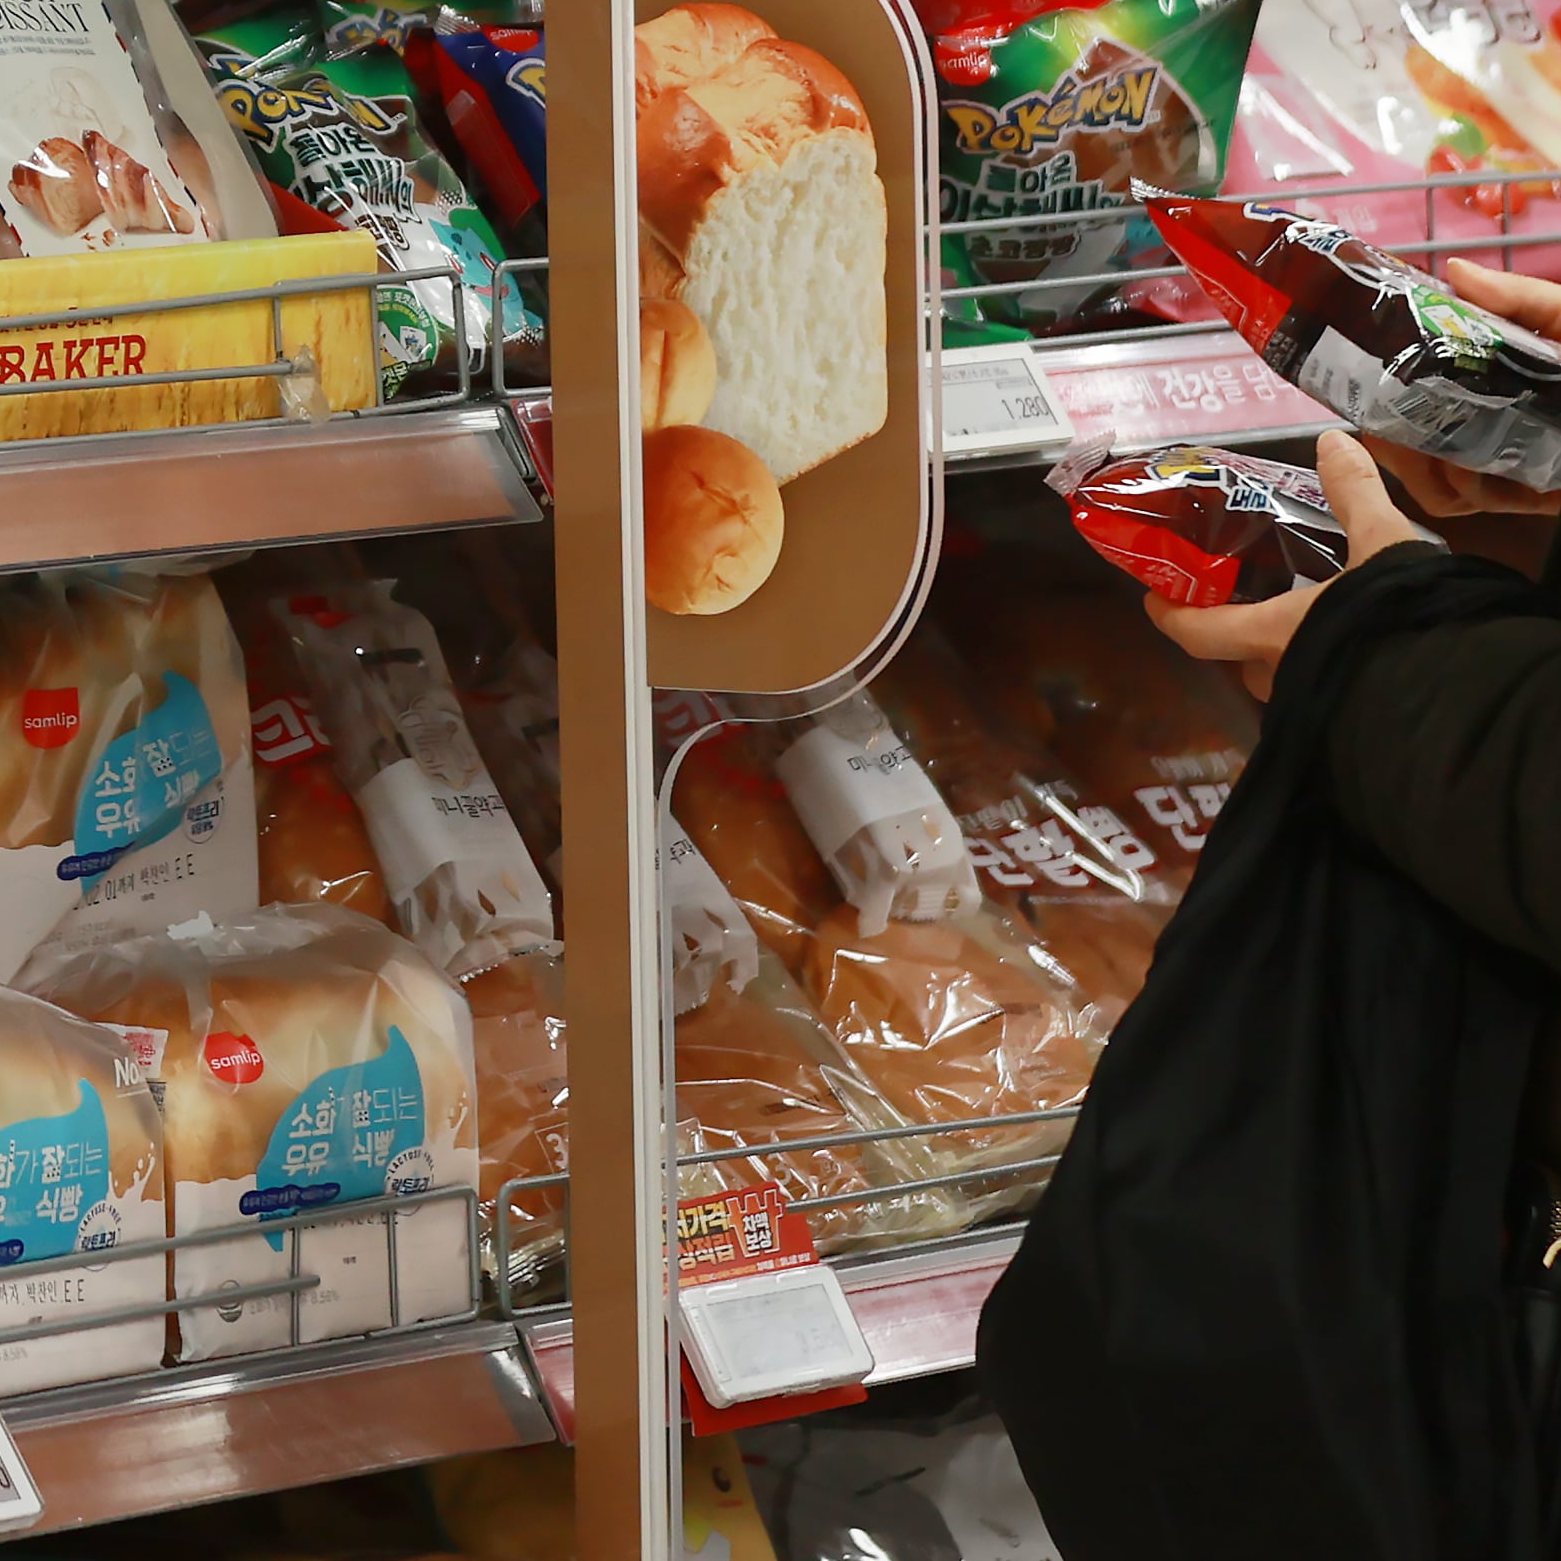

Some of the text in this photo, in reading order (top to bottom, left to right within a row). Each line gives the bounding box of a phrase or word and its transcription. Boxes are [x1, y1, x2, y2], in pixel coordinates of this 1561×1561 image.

[1155, 363, 1247, 413] 건강을
[24, 712, 77, 729] samlip
[94, 801, 142, 839] 우유
[210, 1050, 261, 1070] samlip
[352, 1087, 419, 1129] 잘되는
[40, 1141, 103, 1184] 잘되는
[281, 1140, 331, 1176] 우유
[35, 1186, 84, 1224] 식빵
[741, 1211, 770, 1235] 차액
[743, 1229, 773, 1252] 보상
